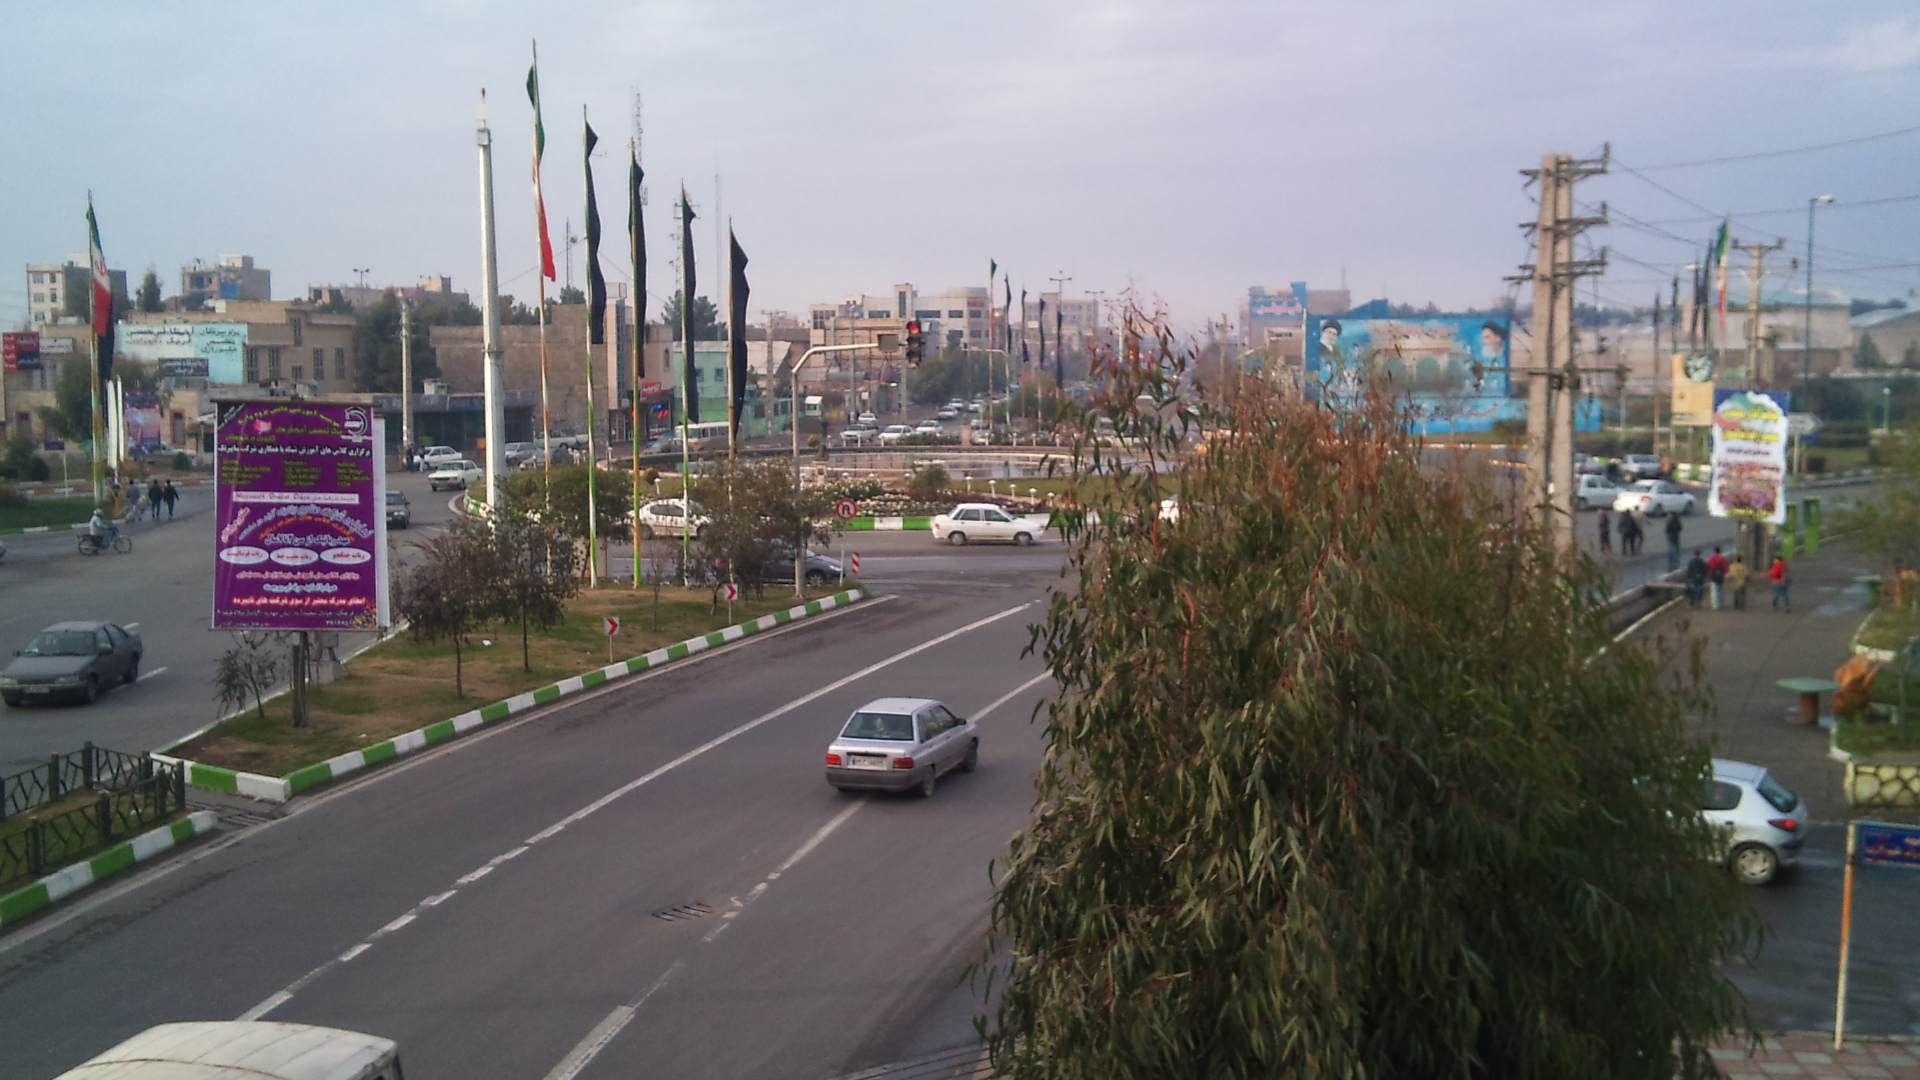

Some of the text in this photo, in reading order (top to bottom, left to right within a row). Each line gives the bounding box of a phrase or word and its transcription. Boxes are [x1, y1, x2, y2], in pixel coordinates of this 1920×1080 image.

[258, 444, 279, 455] همکاری
[298, 445, 319, 456] آموزش
[332, 446, 347, 456] کلاس
[348, 446, 371, 457] برگزاری
